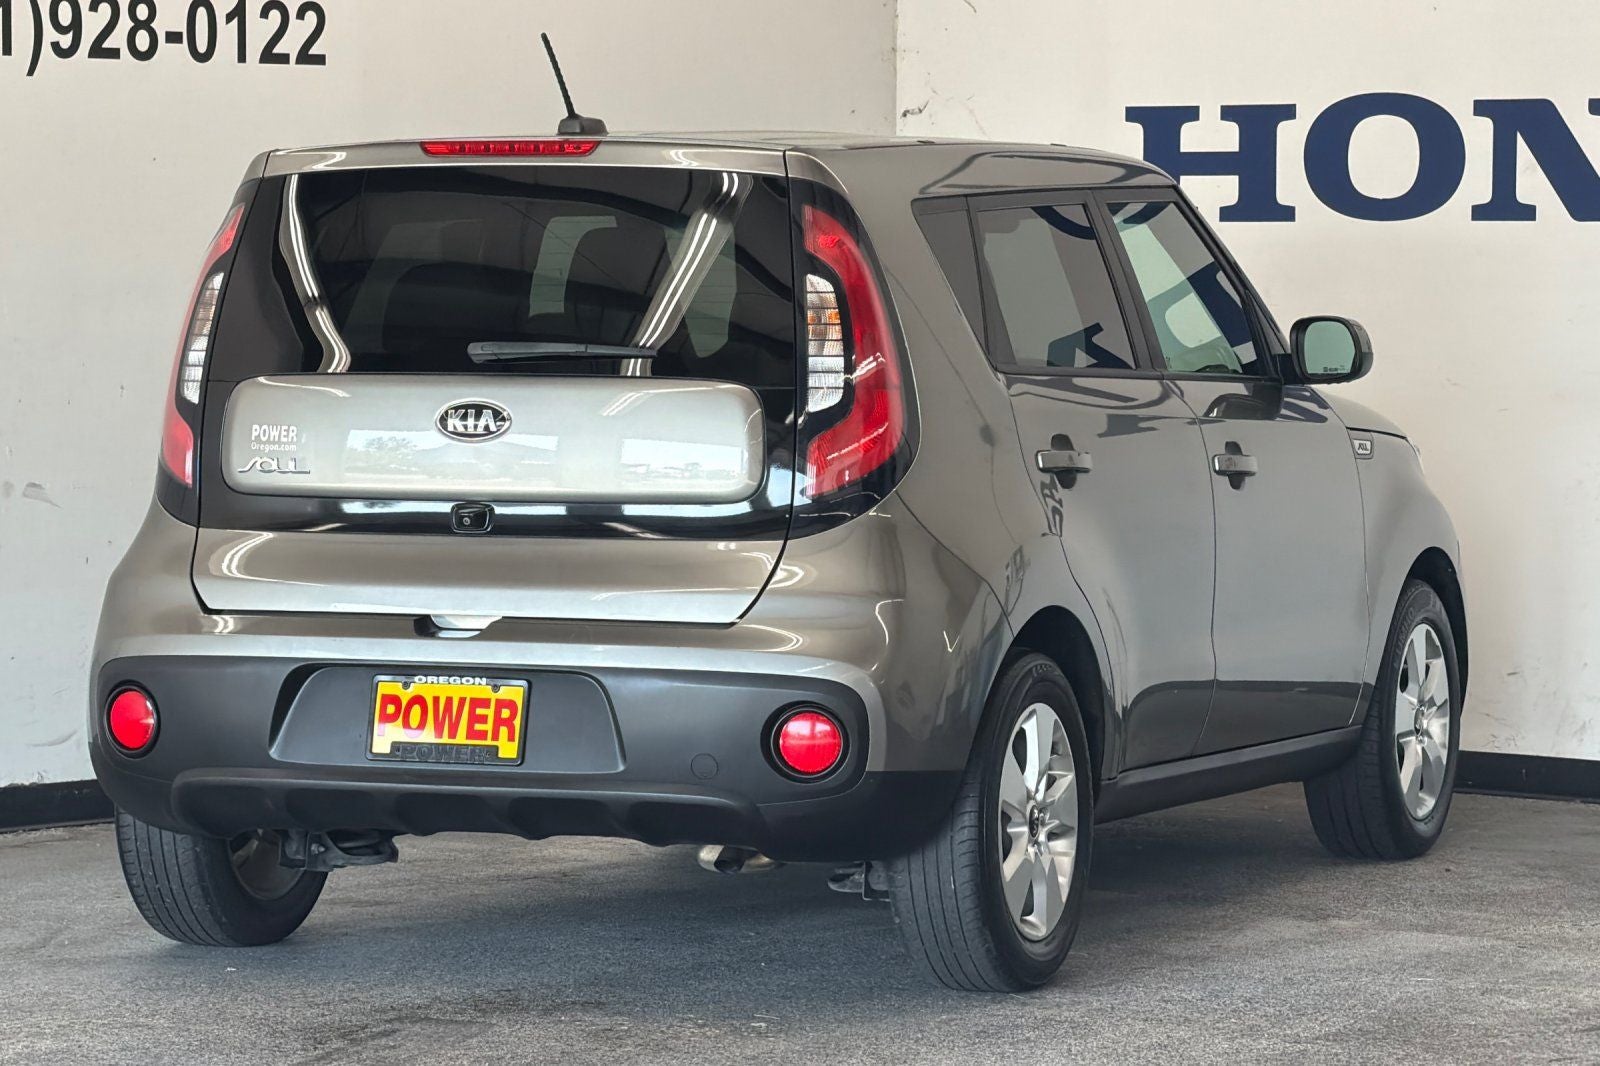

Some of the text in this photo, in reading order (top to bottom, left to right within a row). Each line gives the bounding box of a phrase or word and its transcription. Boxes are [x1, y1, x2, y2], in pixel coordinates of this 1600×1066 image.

[446, 409, 498, 432] KIA
[251, 424, 298, 442] POWER
[250, 441, 298, 453] Oregon.com
[237, 456, 311, 475] SOUL
[414, 675, 487, 686] OREGON
[377, 693, 519, 743] POWER
